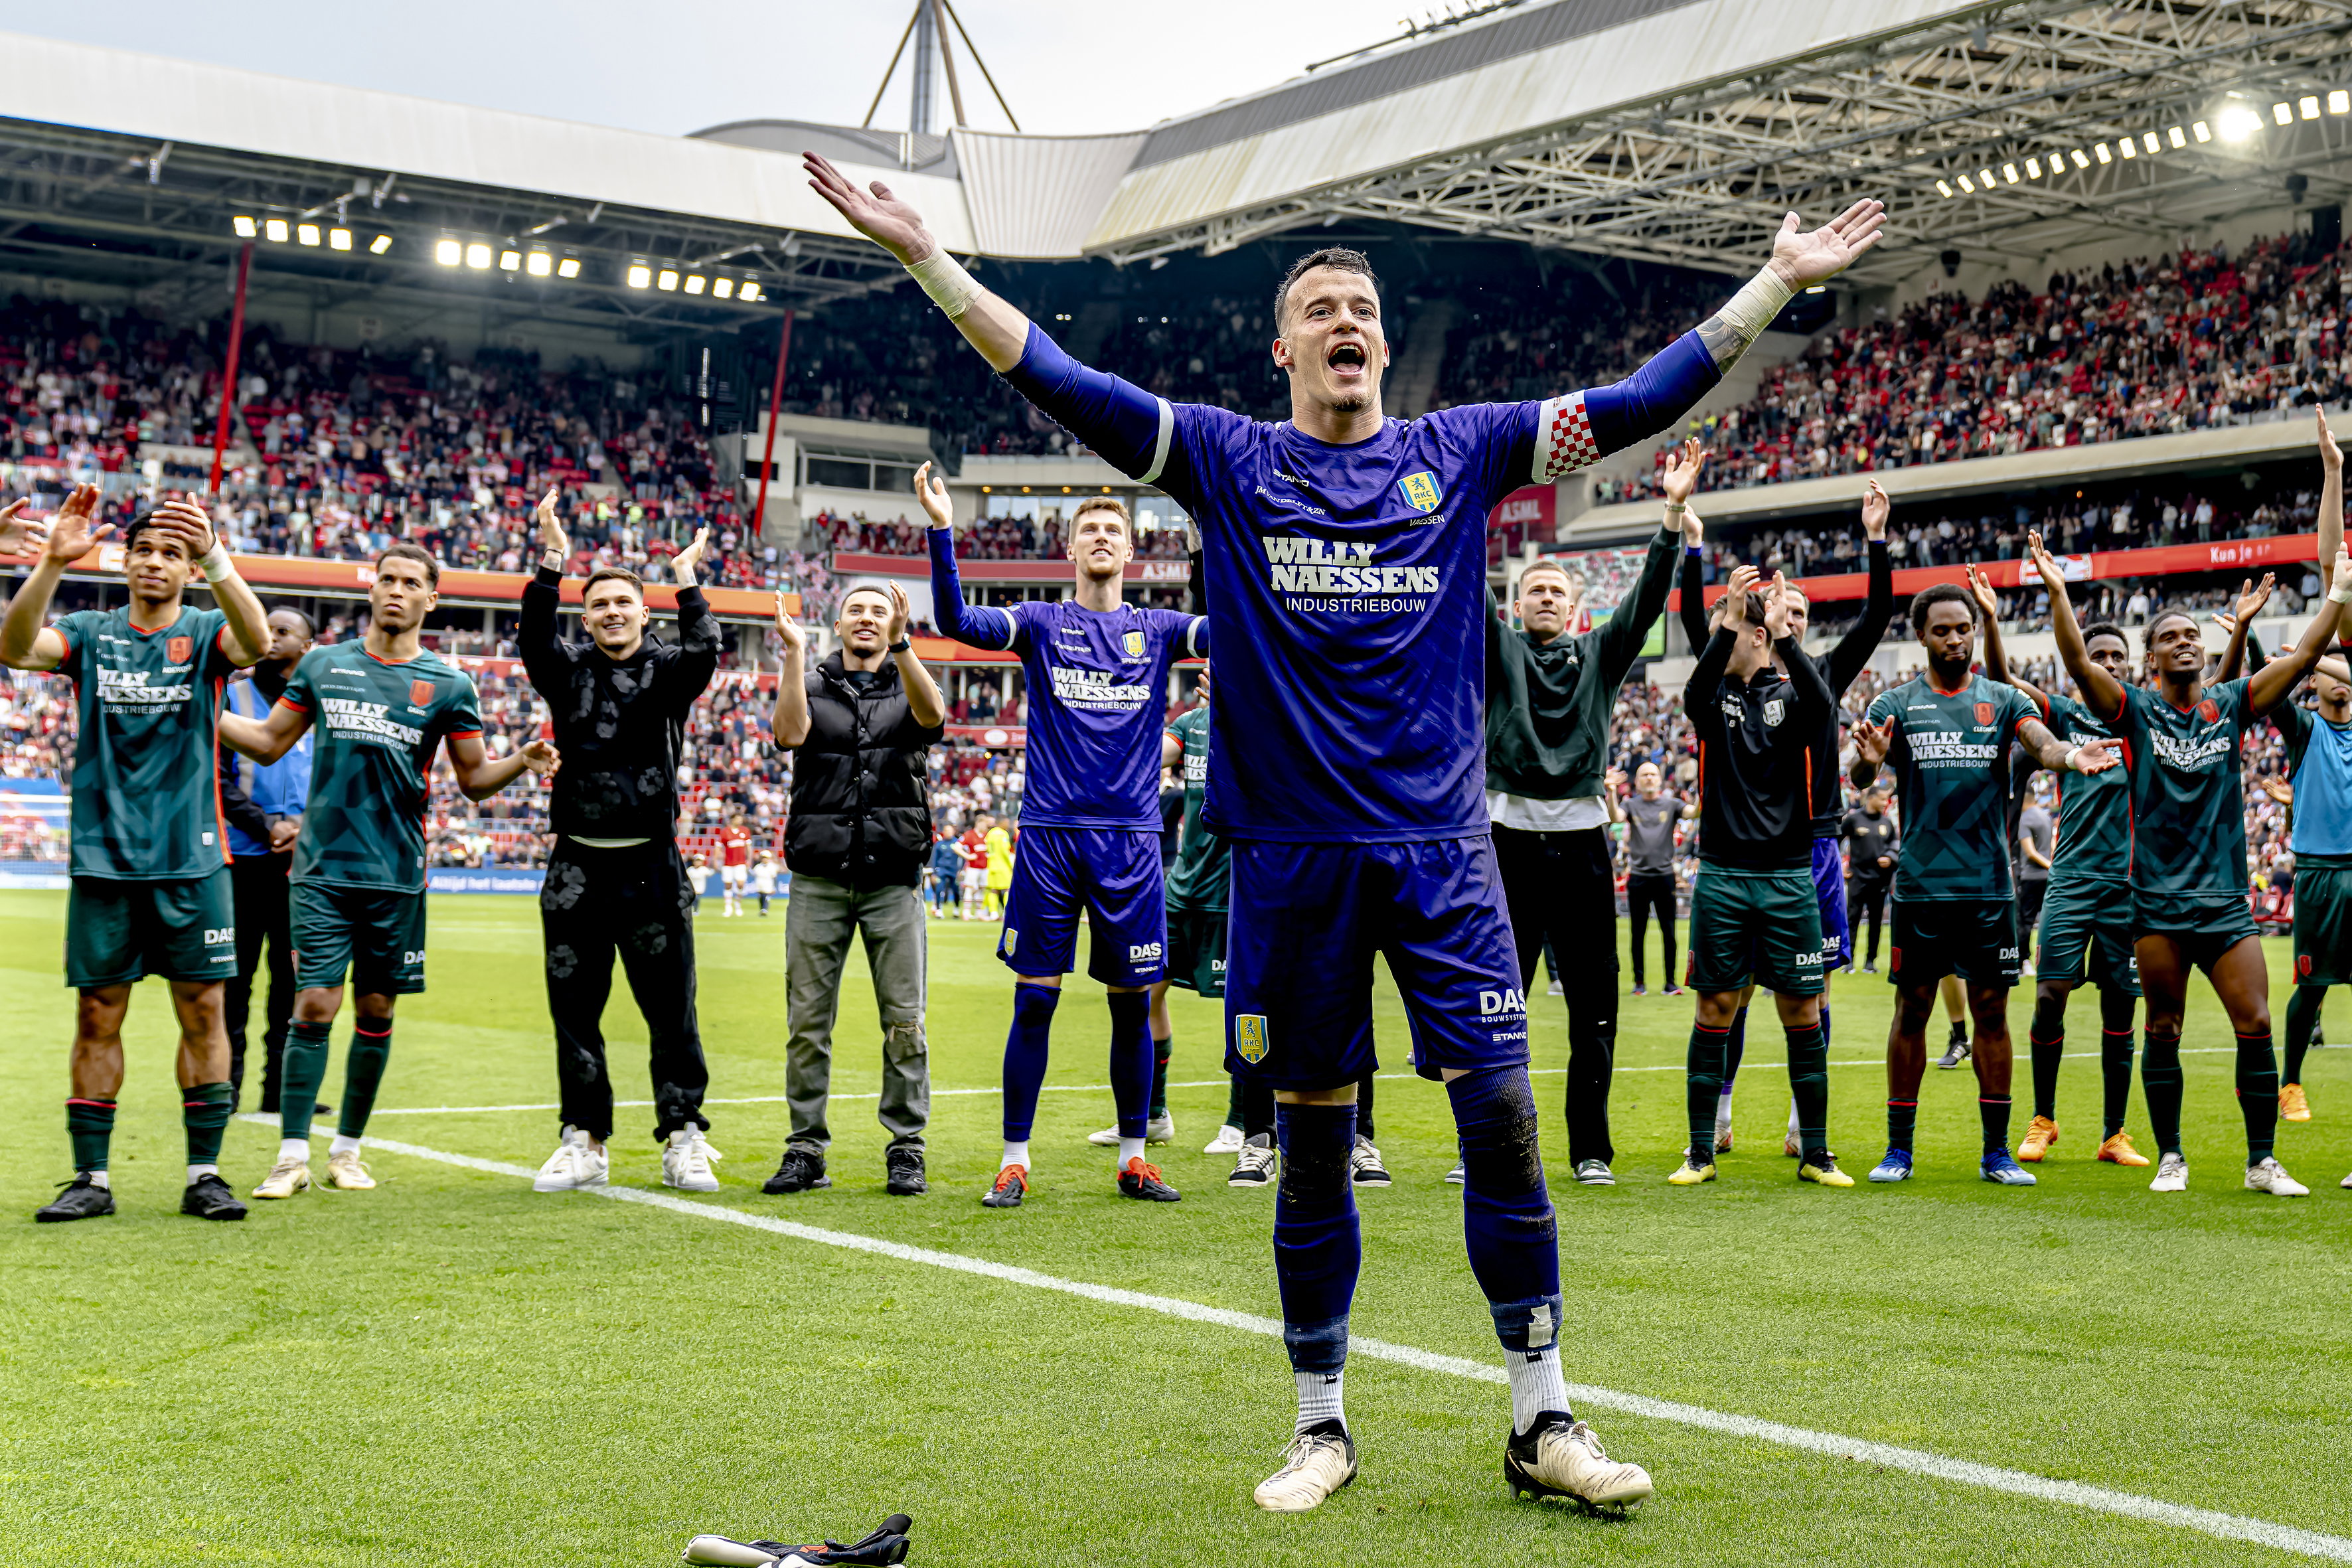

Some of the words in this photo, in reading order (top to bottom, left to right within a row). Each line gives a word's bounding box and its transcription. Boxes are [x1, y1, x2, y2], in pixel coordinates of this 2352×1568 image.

[1414, 490, 1432, 500] RKC
[1500, 499, 1542, 523] ASML
[1409, 514, 1445, 526] VAESSEN
[1263, 536, 1377, 566] WILLY
[1141, 562, 1192, 580] ASML
[1271, 564, 1439, 593] NAESSENS
[1286, 597, 1426, 613] INDUSTRIEBOUW
[1052, 666, 1114, 687] WILLY
[1053, 682, 1151, 701] NAESSENS
[103, 704, 183, 715] DUSTRIEBOUW
[321, 698, 390, 719] WILLY
[1063, 698, 1142, 710] INDUSTRIEBOUW
[325, 713, 425, 745] NAESSENS
[333, 730, 410, 753] INDUSTRIEBOUW
[1906, 731, 1964, 748] WILLY
[1912, 744, 1998, 761] NAESSENS
[1919, 759, 1991, 770] INDUSTRIEBOUW
[404, 950, 426, 965] DA
[1129, 941, 1162, 959] DAS
[1796, 951, 1823, 966] DAS
[1212, 959, 1227, 971] DA
[1479, 988, 1526, 1015] DAS
[1244, 1038, 1260, 1047] RKC
